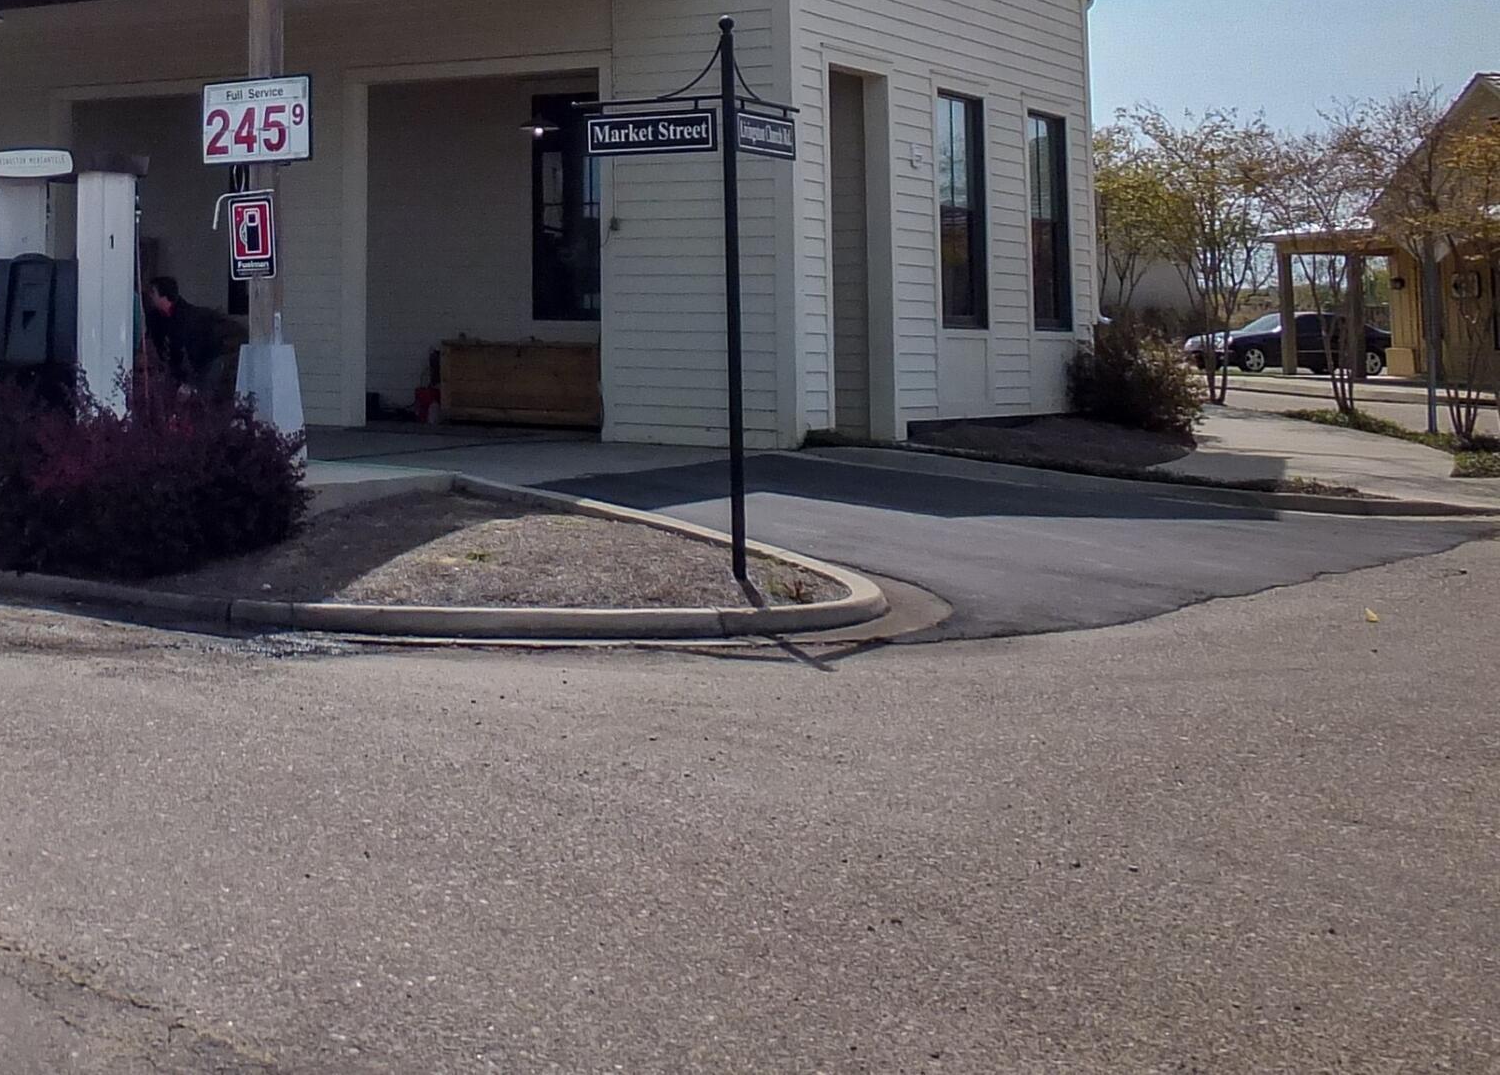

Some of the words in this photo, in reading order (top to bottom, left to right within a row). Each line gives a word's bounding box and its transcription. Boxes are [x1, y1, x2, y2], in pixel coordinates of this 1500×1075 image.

[226, 90, 243, 101] Full
[248, 88, 284, 99] Service
[593, 123, 653, 143] Market
[658, 121, 707, 140] Street
[109, 234, 114, 249] 1
